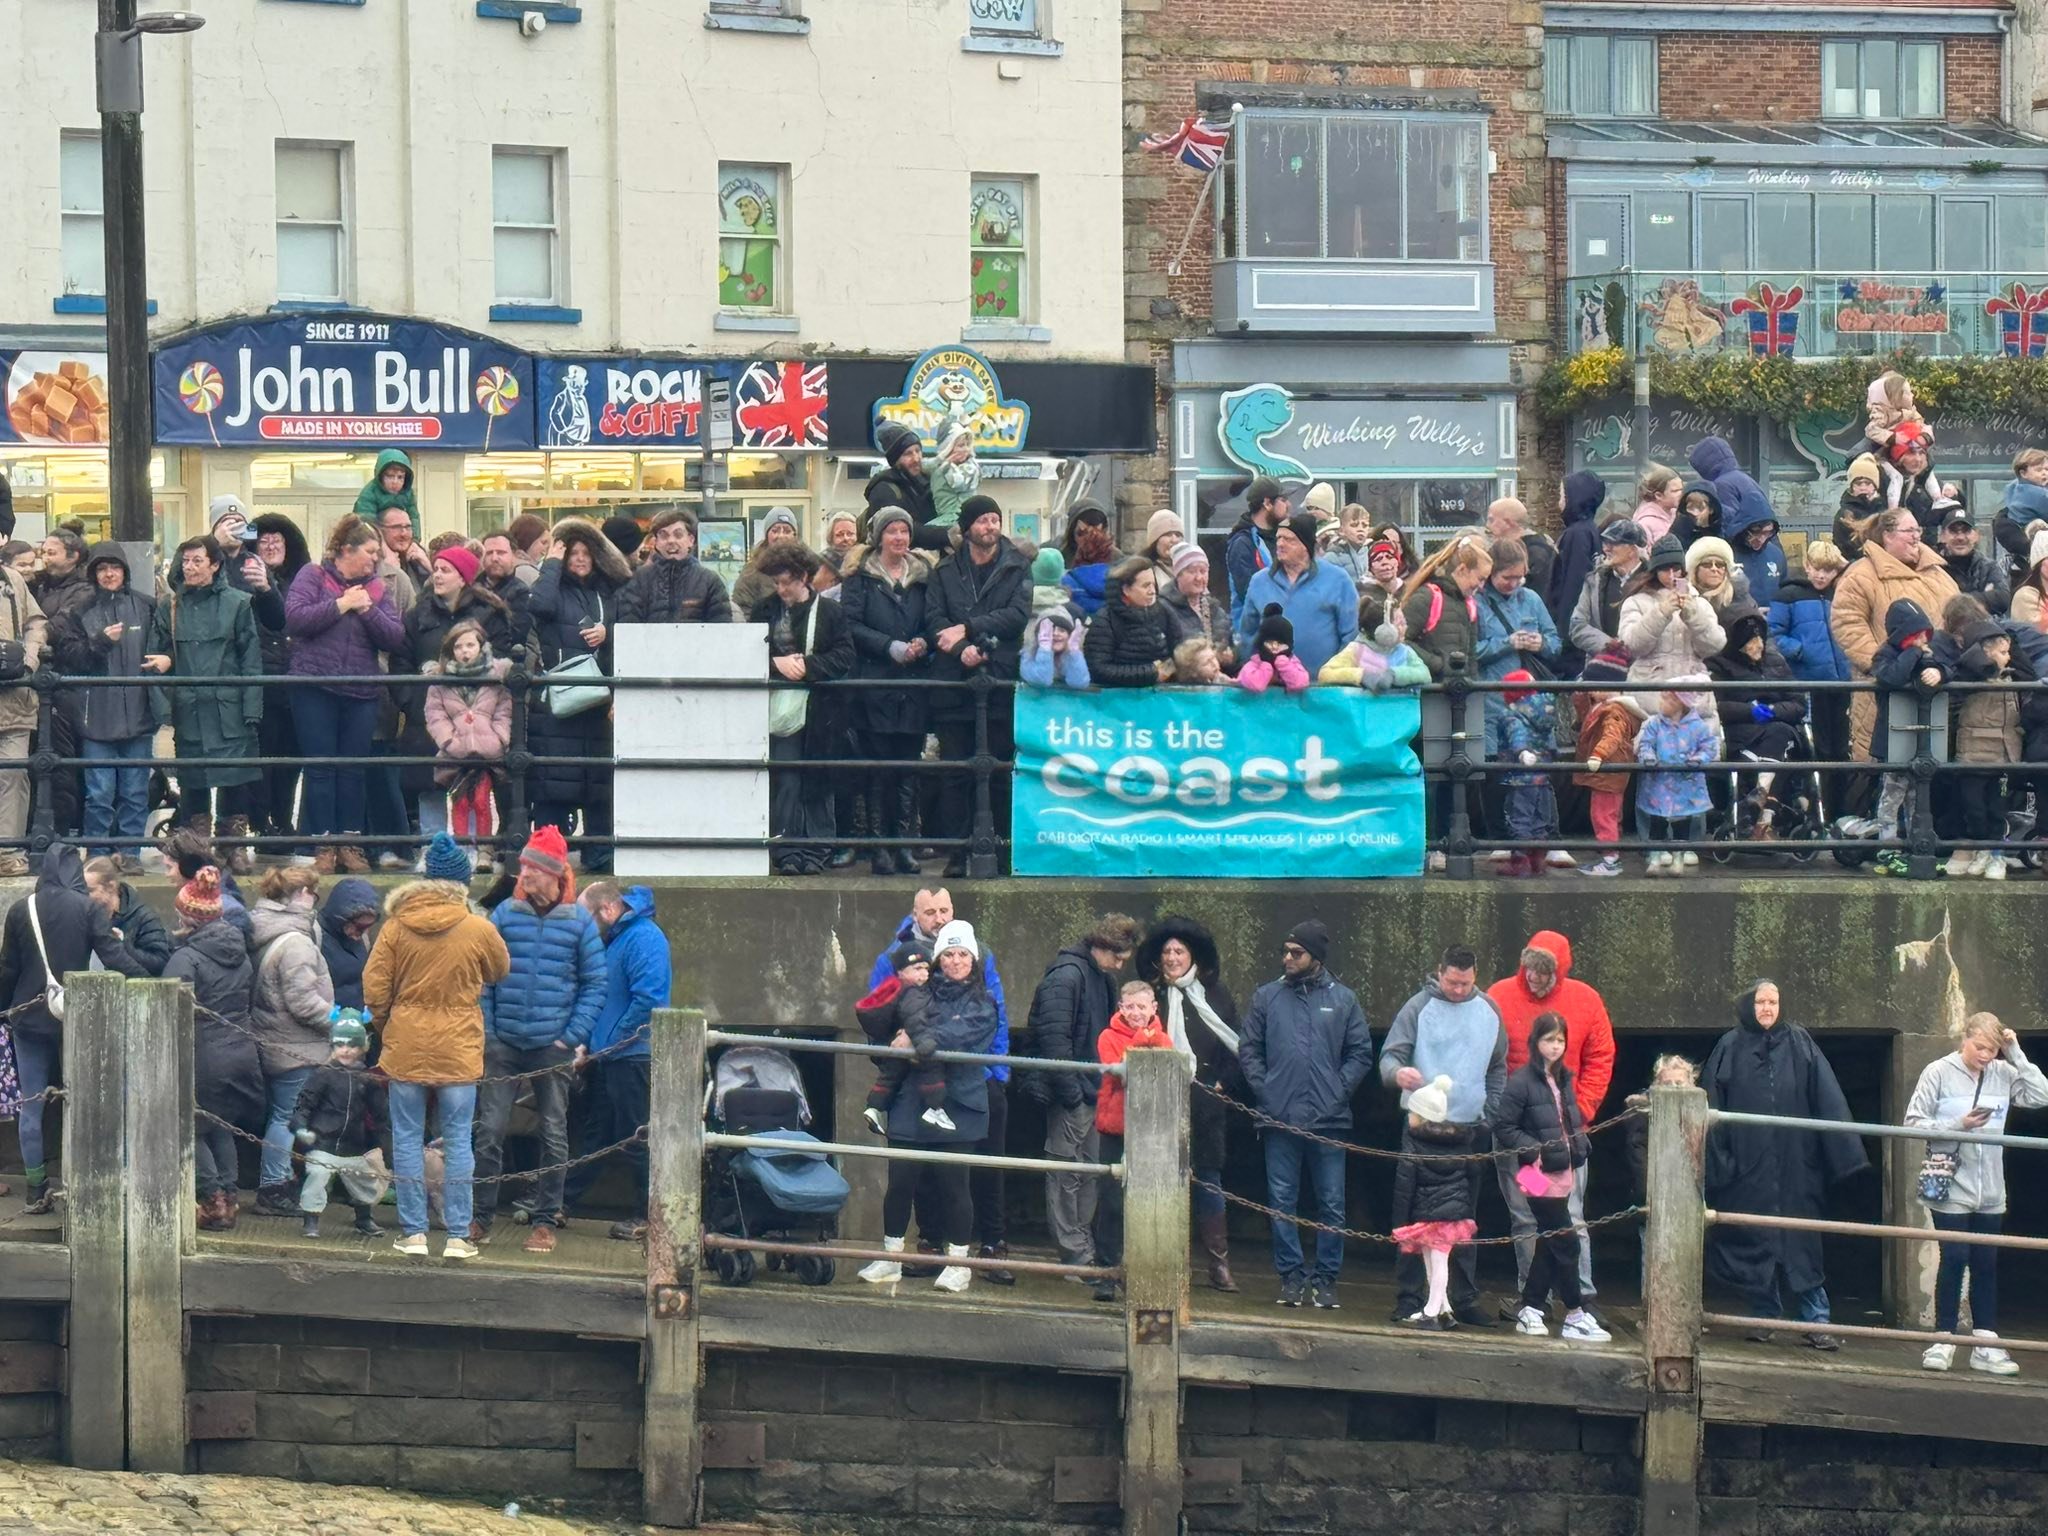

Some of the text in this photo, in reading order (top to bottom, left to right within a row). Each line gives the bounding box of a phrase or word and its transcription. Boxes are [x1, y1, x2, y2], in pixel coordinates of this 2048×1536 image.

[1747, 168, 1884, 190] Winking Willy's
[305, 322, 390, 341] SINCE 1911
[225, 345, 470, 427] John Bull
[606, 368, 701, 404] ROCK
[911, 356, 941, 400] UDDERLY
[944, 351, 976, 371] DIVINE
[281, 420, 423, 436] MADE IN YORKSHIRE
[1298, 415, 1485, 456] Winking Willy's
[1046, 717, 1224, 749] this is the
[1041, 735, 1342, 806] coast
[1120, 833, 1163, 845] RADIO
[1176, 833, 1221, 845] SMART
[1308, 833, 1335, 845] APP
[1348, 832, 1400, 845] ONLINE
